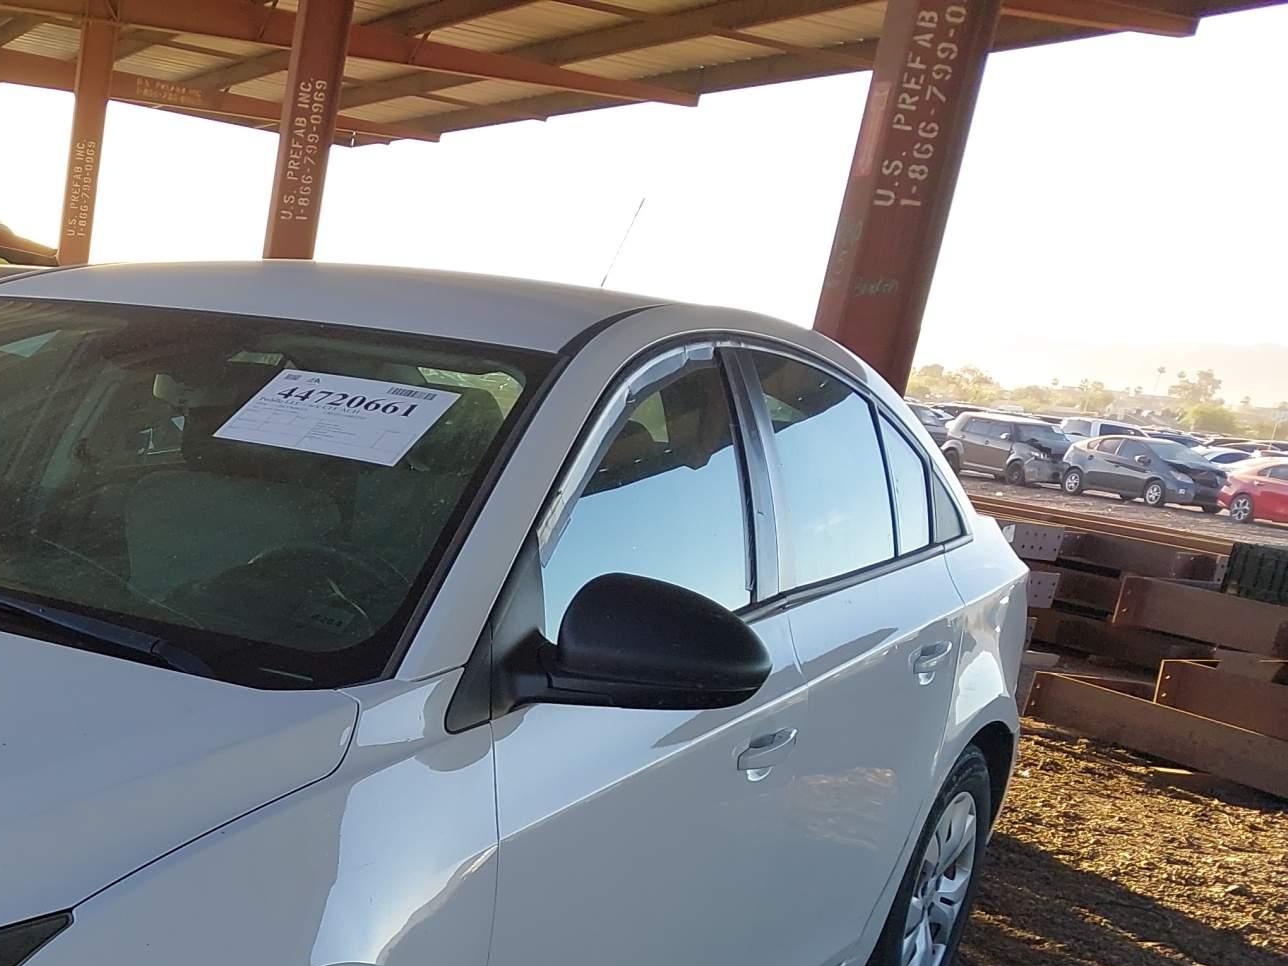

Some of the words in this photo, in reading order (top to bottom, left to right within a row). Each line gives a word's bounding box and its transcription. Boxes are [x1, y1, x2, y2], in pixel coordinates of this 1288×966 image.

[297, 77, 314, 109] INC.
[873, 151, 907, 207] U.S.
[892, 9, 939, 132] PREFAB
[900, 0, 969, 207] 1-866-799-0
[286, 116, 307, 181] PREFAB
[295, 79, 328, 221] 1-866-799-0969
[69, 166, 83, 209] PREFAB
[280, 190, 298, 221] U.S.
[66, 215, 78, 237] U.S.
[277, 385, 419, 418] 44720661
